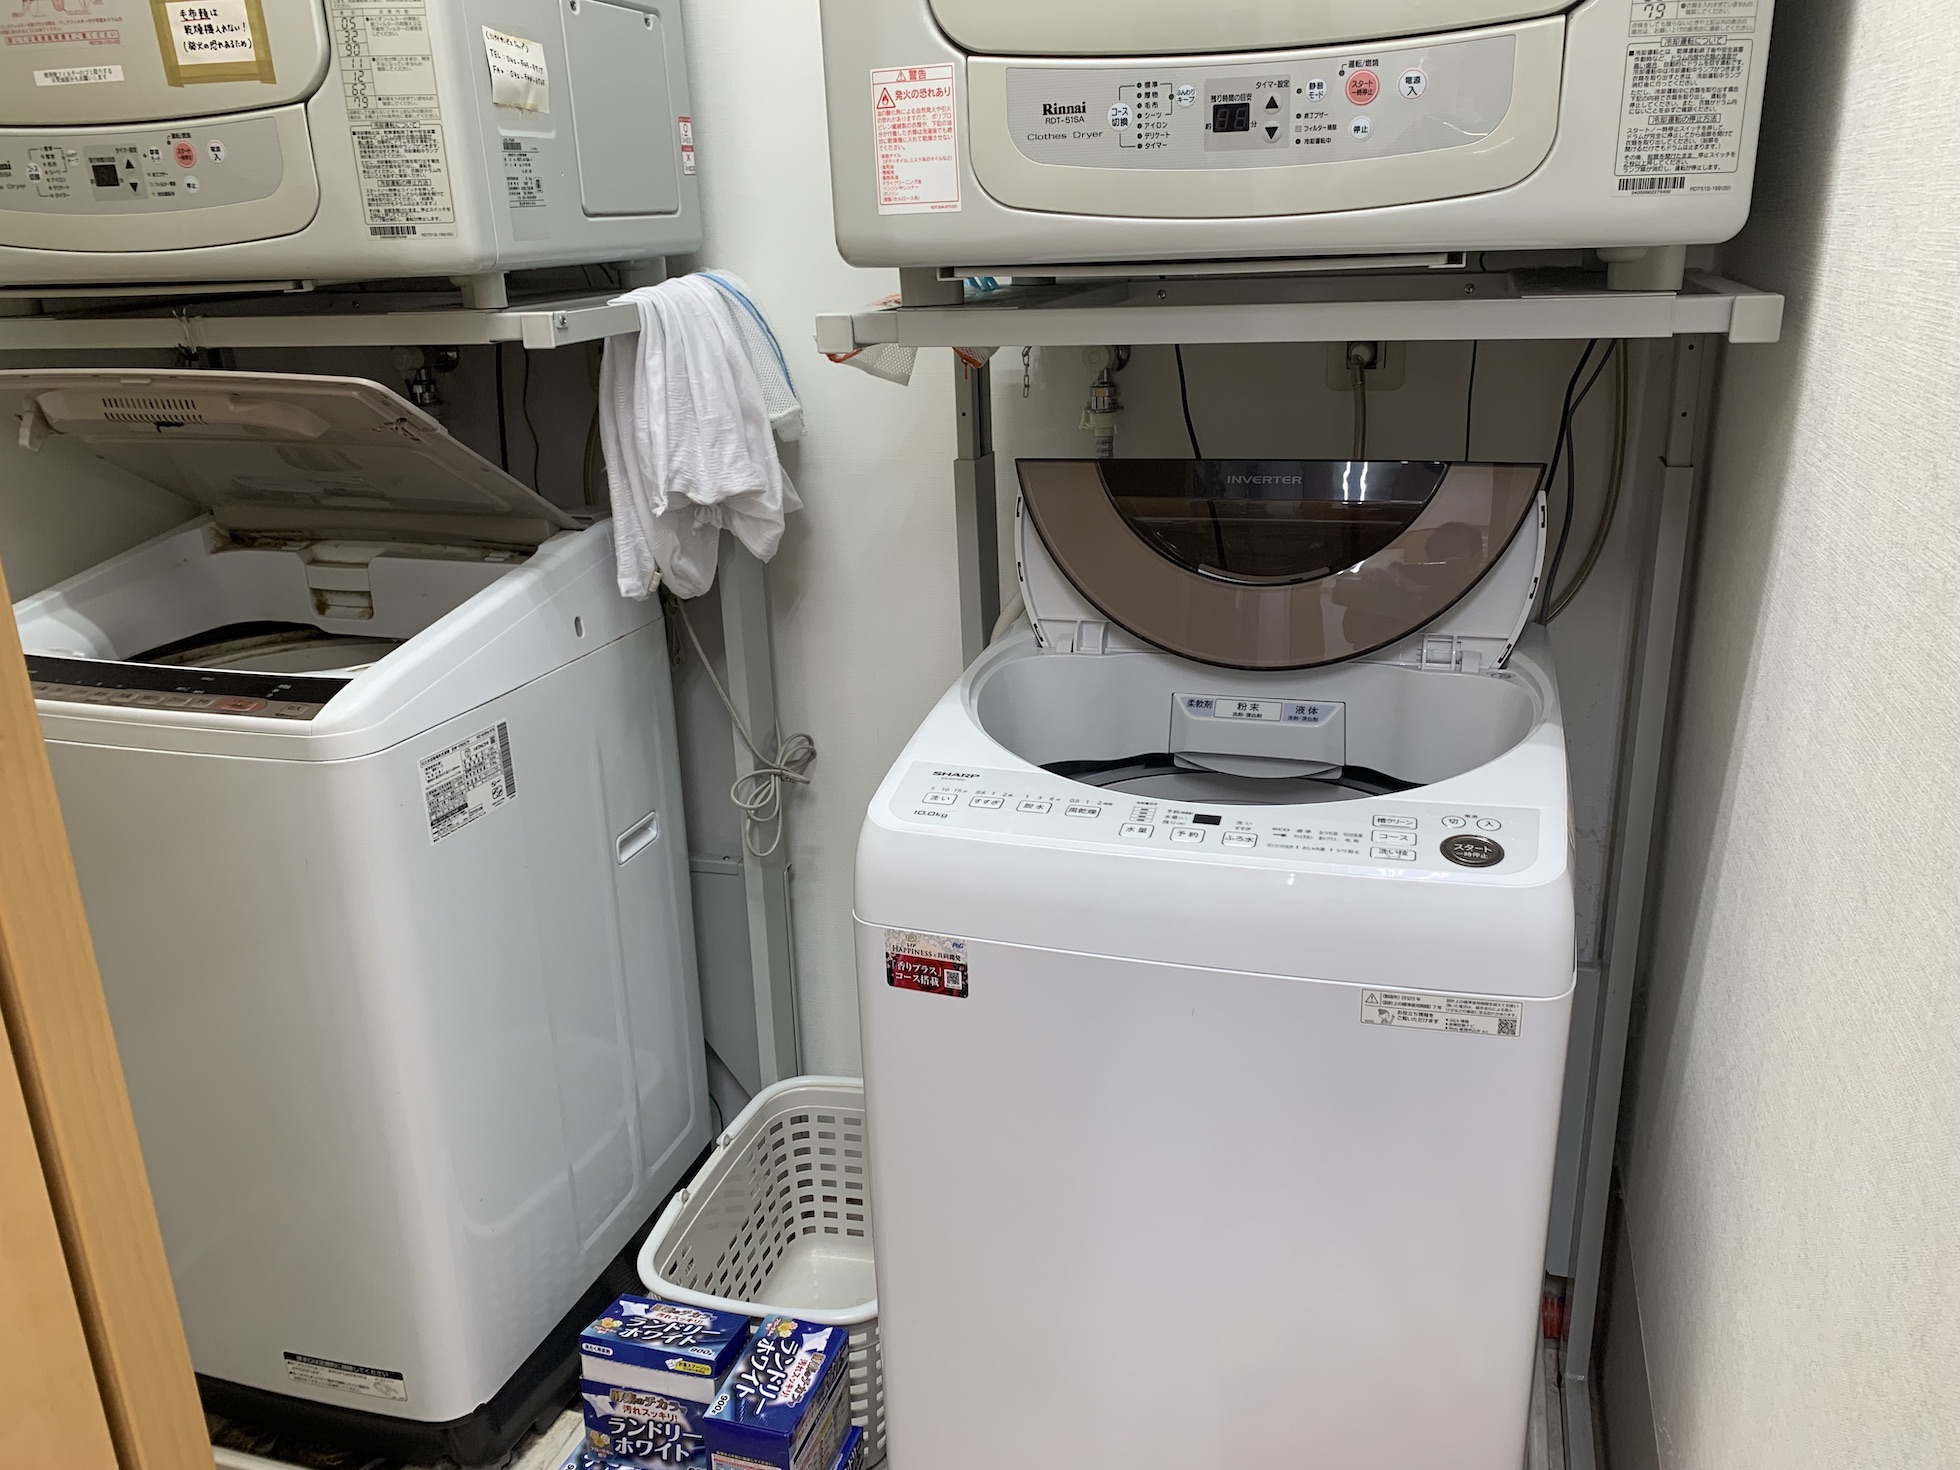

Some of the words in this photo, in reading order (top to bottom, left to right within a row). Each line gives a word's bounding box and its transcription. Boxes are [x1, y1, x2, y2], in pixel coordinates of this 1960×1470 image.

[180, 8, 218, 21] 毛布類は
[1644, 3, 1666, 19] 79
[342, 17, 356, 30] 05
[345, 31, 358, 43] 32
[1664, 36, 1724, 46] 冷却運転について
[346, 44, 360, 56] 90
[352, 59, 362, 68] 11
[1348, 59, 1378, 68] 運転/燃焼
[354, 70, 364, 83] 12
[909, 69, 926, 80] 警告
[1256, 80, 1290, 89] タイマー設定
[1352, 80, 1373, 88] スタート
[1405, 76, 1420, 84] 電源
[352, 83, 366, 95] 62
[1308, 82, 1324, 90] 静音
[1407, 86, 1417, 96] 入
[895, 86, 951, 100] 発火の恐れあり
[1308, 91, 1323, 99] モード
[1352, 88, 1373, 96] 一時停止
[1210, 93, 1252, 102] 残り時間の目安
[354, 97, 368, 109] 79
[1042, 101, 1086, 116] Rinnai
[1112, 108, 1128, 116] コース
[1045, 116, 1085, 124] RDT-51SA
[1112, 118, 1128, 126] 切換
[1652, 115, 1718, 124] 冷却運転の停止方法
[1027, 132, 1067, 141] Clothes
[1073, 131, 1104, 140] Dryer
[1228, 475, 1302, 485] INVERTER
[1187, 699, 1213, 709] 柔軟剤
[1237, 702, 1260, 711] 粉末
[1295, 705, 1318, 715] 液体
[914, 810, 948, 818] 10.0kg
[1225, 835, 1254, 843] ふろ水
[1454, 844, 1492, 853] スタート
[892, 945, 932, 957] HAPPINESS
[895, 972, 940, 987] コース搭載
[656, 1312, 703, 1325] 汚れスッキリ!
[626, 1316, 721, 1335] ランドリー
[619, 1328, 696, 1346] ホワイト
[690, 1347, 713, 1356] 900g
[736, 1338, 775, 1398] ホワイト
[756, 1340, 798, 1414] ランドリー
[781, 1359, 807, 1398] 汚れスッキリ!
[712, 1395, 728, 1414] 900g
[623, 1405, 678, 1422] 汚れスッキリ!
[608, 1417, 702, 1442] ランドリー
[615, 1437, 690, 1462] ホワイト
